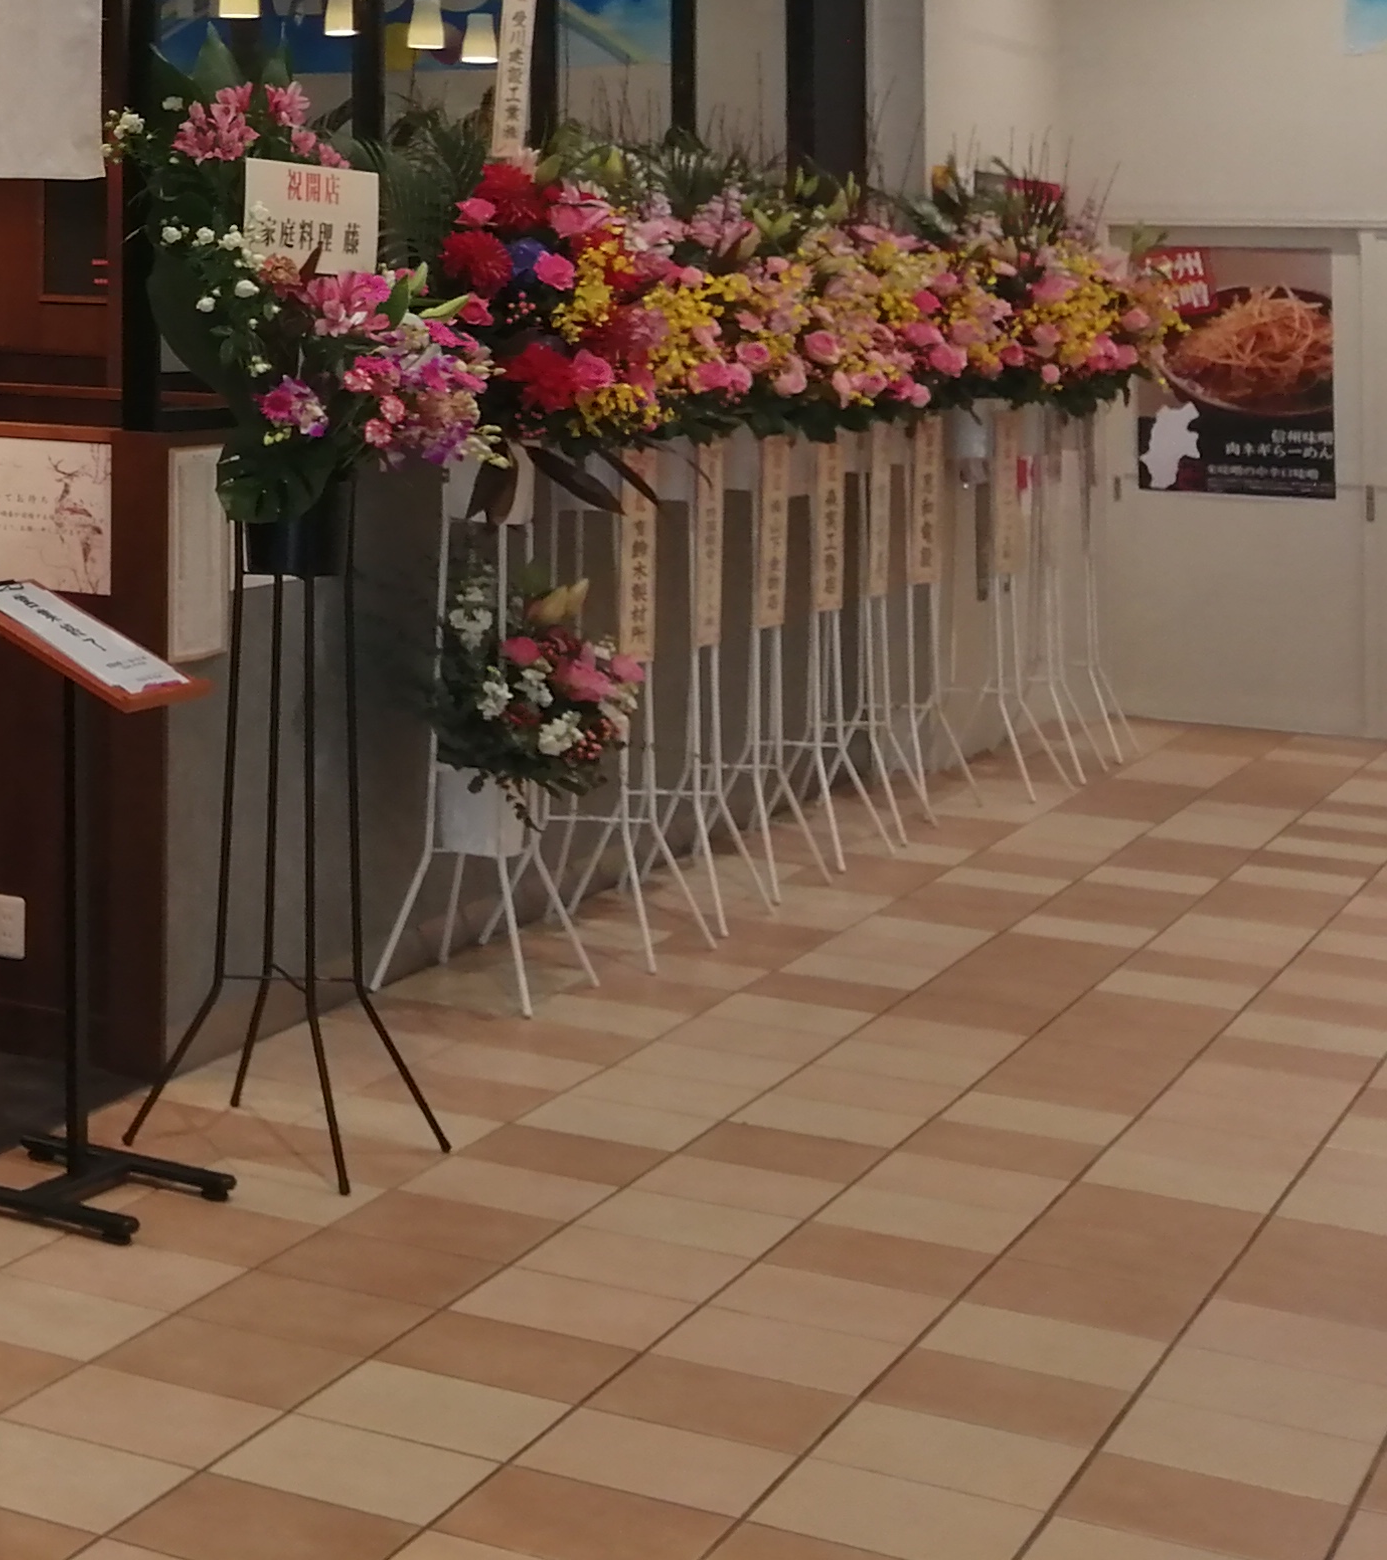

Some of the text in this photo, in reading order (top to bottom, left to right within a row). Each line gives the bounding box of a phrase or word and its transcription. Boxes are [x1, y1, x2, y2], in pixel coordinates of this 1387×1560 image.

[287, 169, 341, 205] 祝開店
[261, 216, 334, 253] 家庭料理
